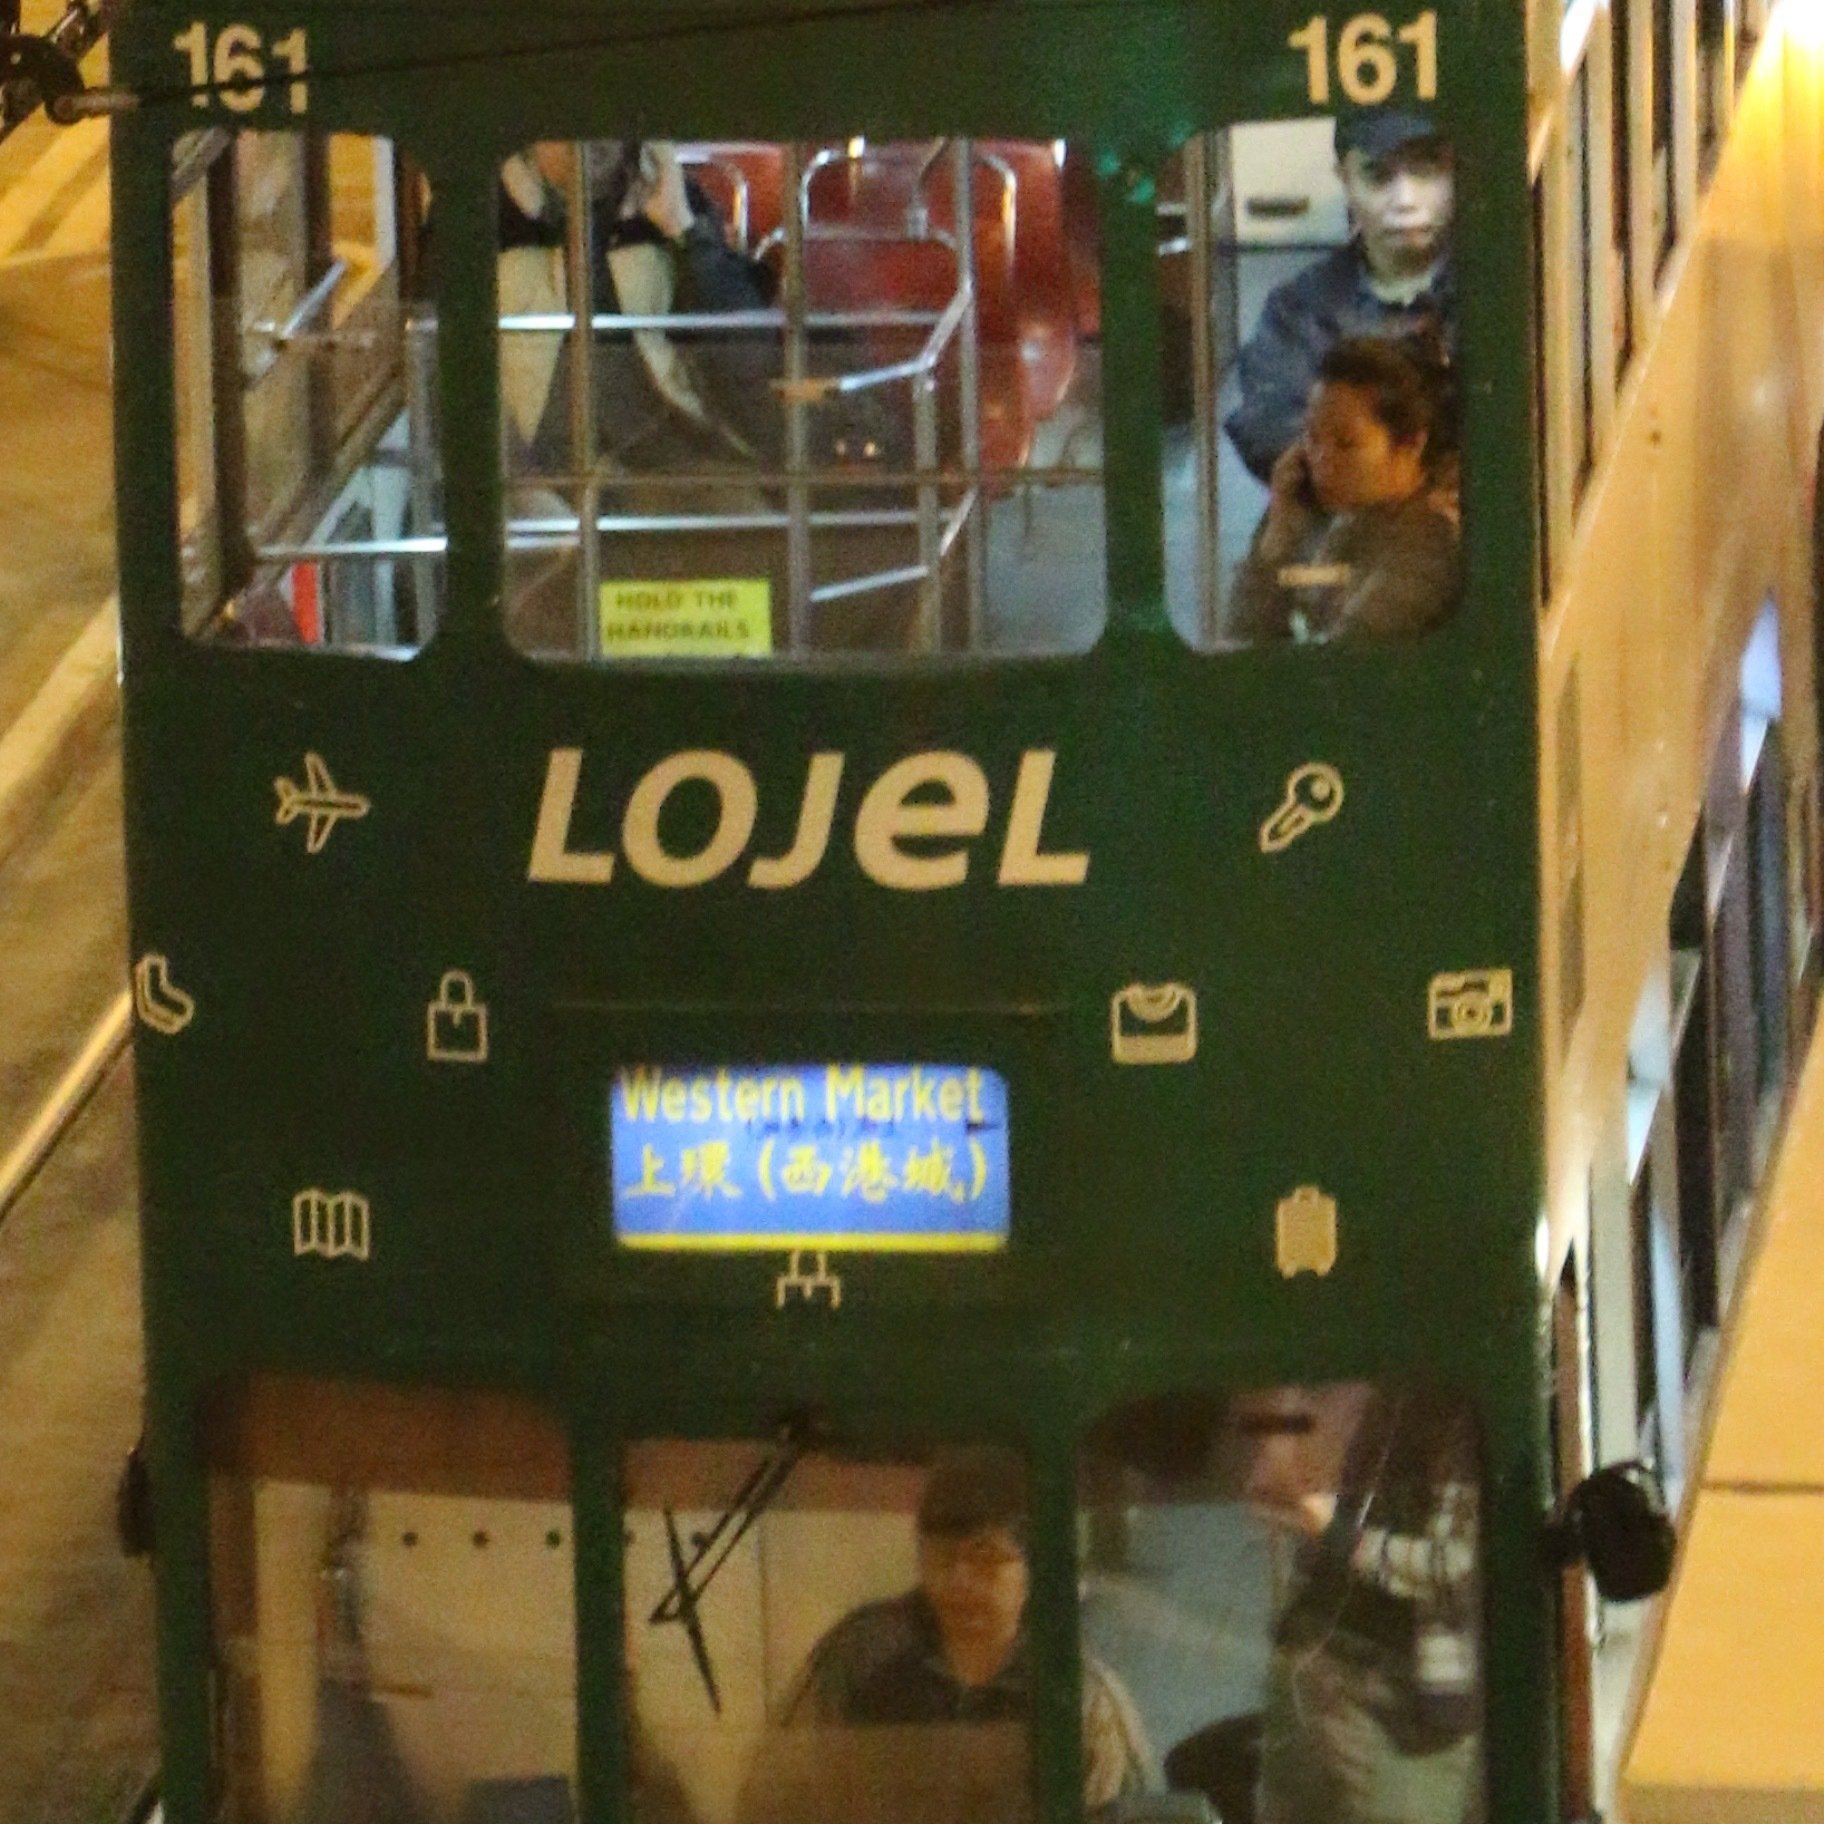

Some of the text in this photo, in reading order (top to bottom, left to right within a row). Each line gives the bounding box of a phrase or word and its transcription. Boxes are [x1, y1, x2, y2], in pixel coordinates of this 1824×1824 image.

[174, 21, 308, 115] 161
[1287, 8, 1438, 106] 161
[619, 1062, 984, 1124] Western Market
